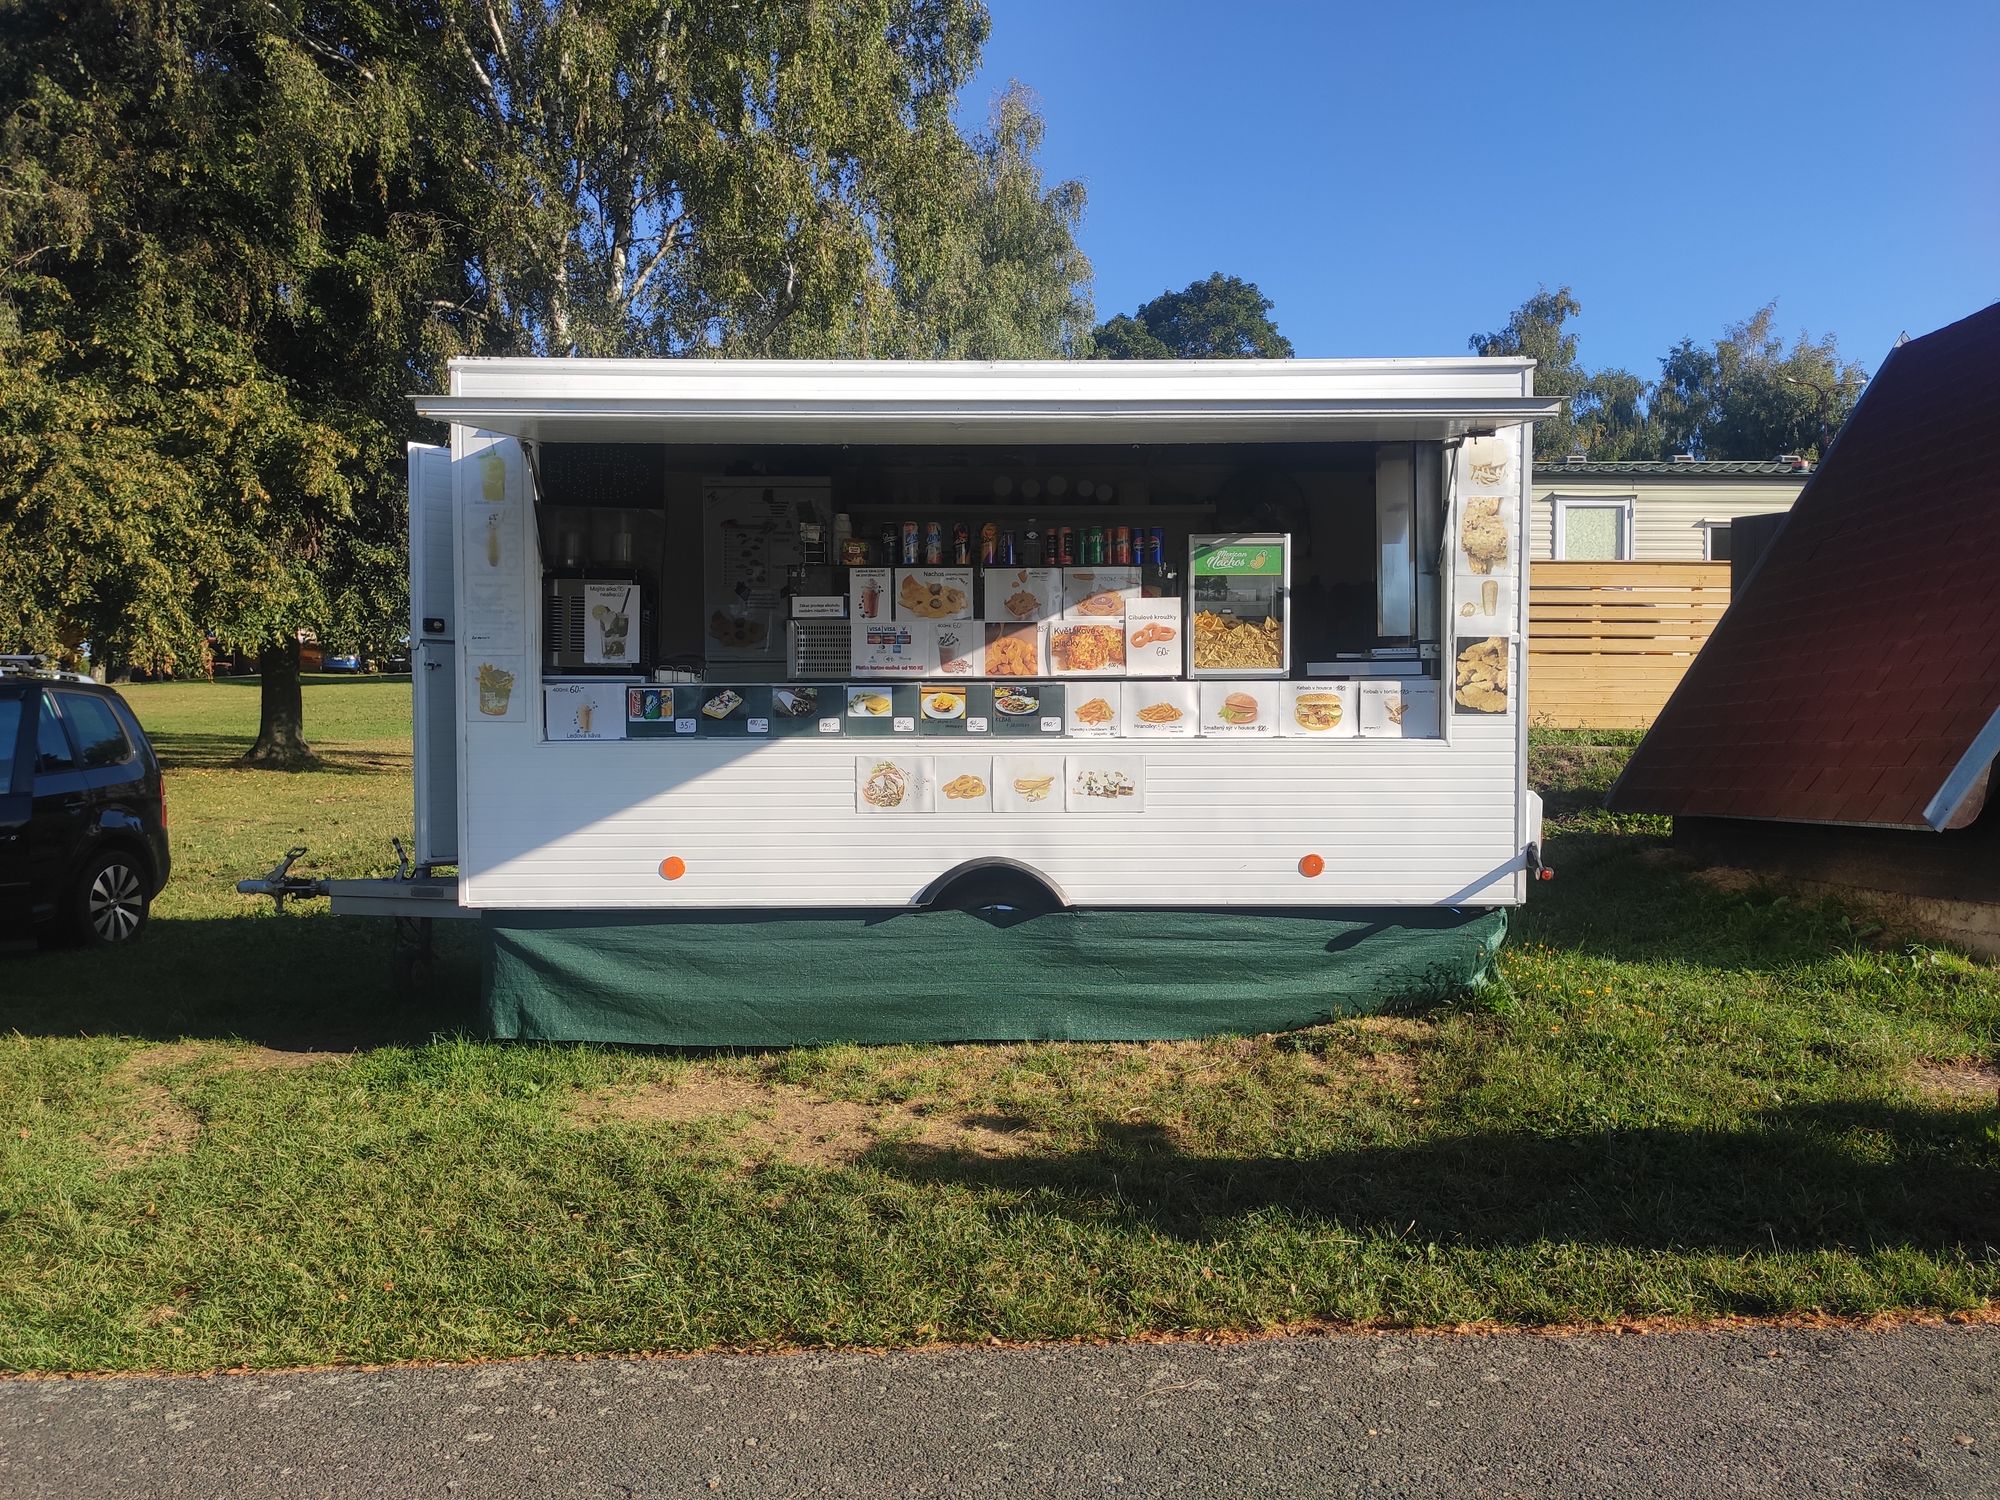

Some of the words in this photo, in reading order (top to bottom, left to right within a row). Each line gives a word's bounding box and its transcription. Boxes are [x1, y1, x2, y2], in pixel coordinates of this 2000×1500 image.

[1217, 549, 1248, 557] Mexican
[1206, 555, 1246, 570] Nachos
[1154, 613, 1177, 621] kroužky
[1053, 626, 1096, 635] Květákové
[1053, 638, 1080, 648] placky
